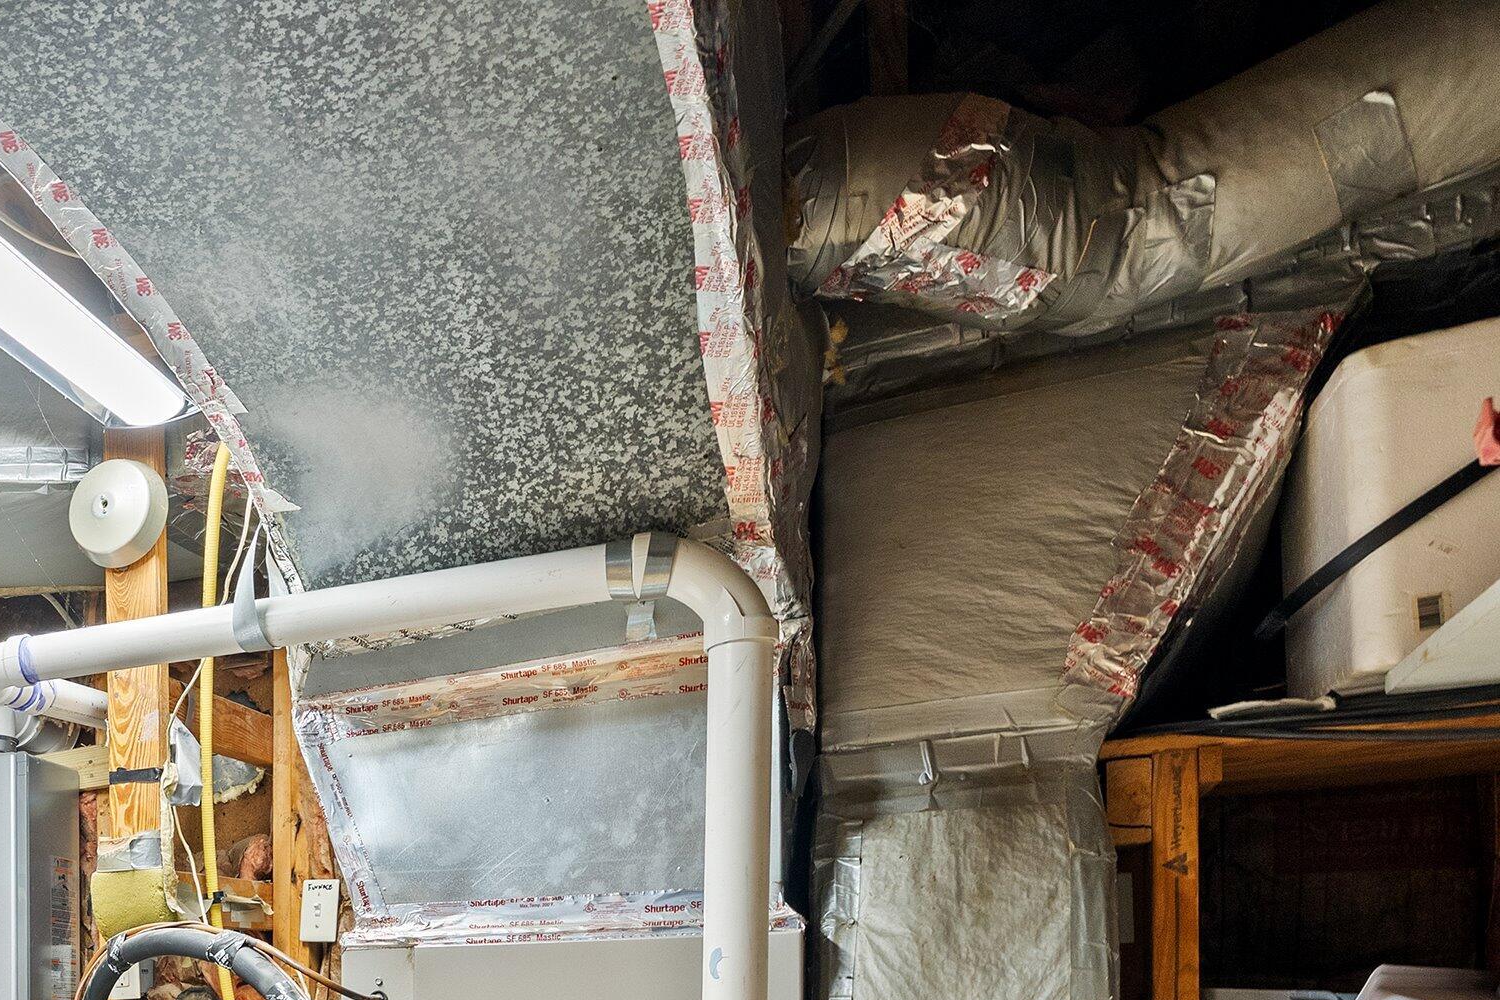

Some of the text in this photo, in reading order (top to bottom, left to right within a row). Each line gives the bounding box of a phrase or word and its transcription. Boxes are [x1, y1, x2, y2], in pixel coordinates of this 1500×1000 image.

[51, 182, 70, 204] 3M
[92, 228, 110, 249] 3M
[135, 276, 153, 298] 3M
[167, 322, 183, 341] 3M
[501, 667, 537, 680] Shurtape
[541, 664, 552, 673] SF
[553, 661, 567, 672] 685
[572, 658, 597, 668] Mastic
[345, 703, 379, 715] Shurtape
[382, 699, 392, 708] SF
[393, 697, 405, 707] 685
[408, 694, 432, 704] Mastic
[502, 684, 598, 706] Shurtape SF 685 Mastic
[382, 723, 392, 733] SF
[409, 719, 432, 729] Mastic
[355, 880, 372, 913] Shurtape
[643, 900, 702, 914] Shurtape SF
[506, 934, 517, 943] SF
[518, 934, 532, 943] 685
[536, 933, 562, 943] Mastic
